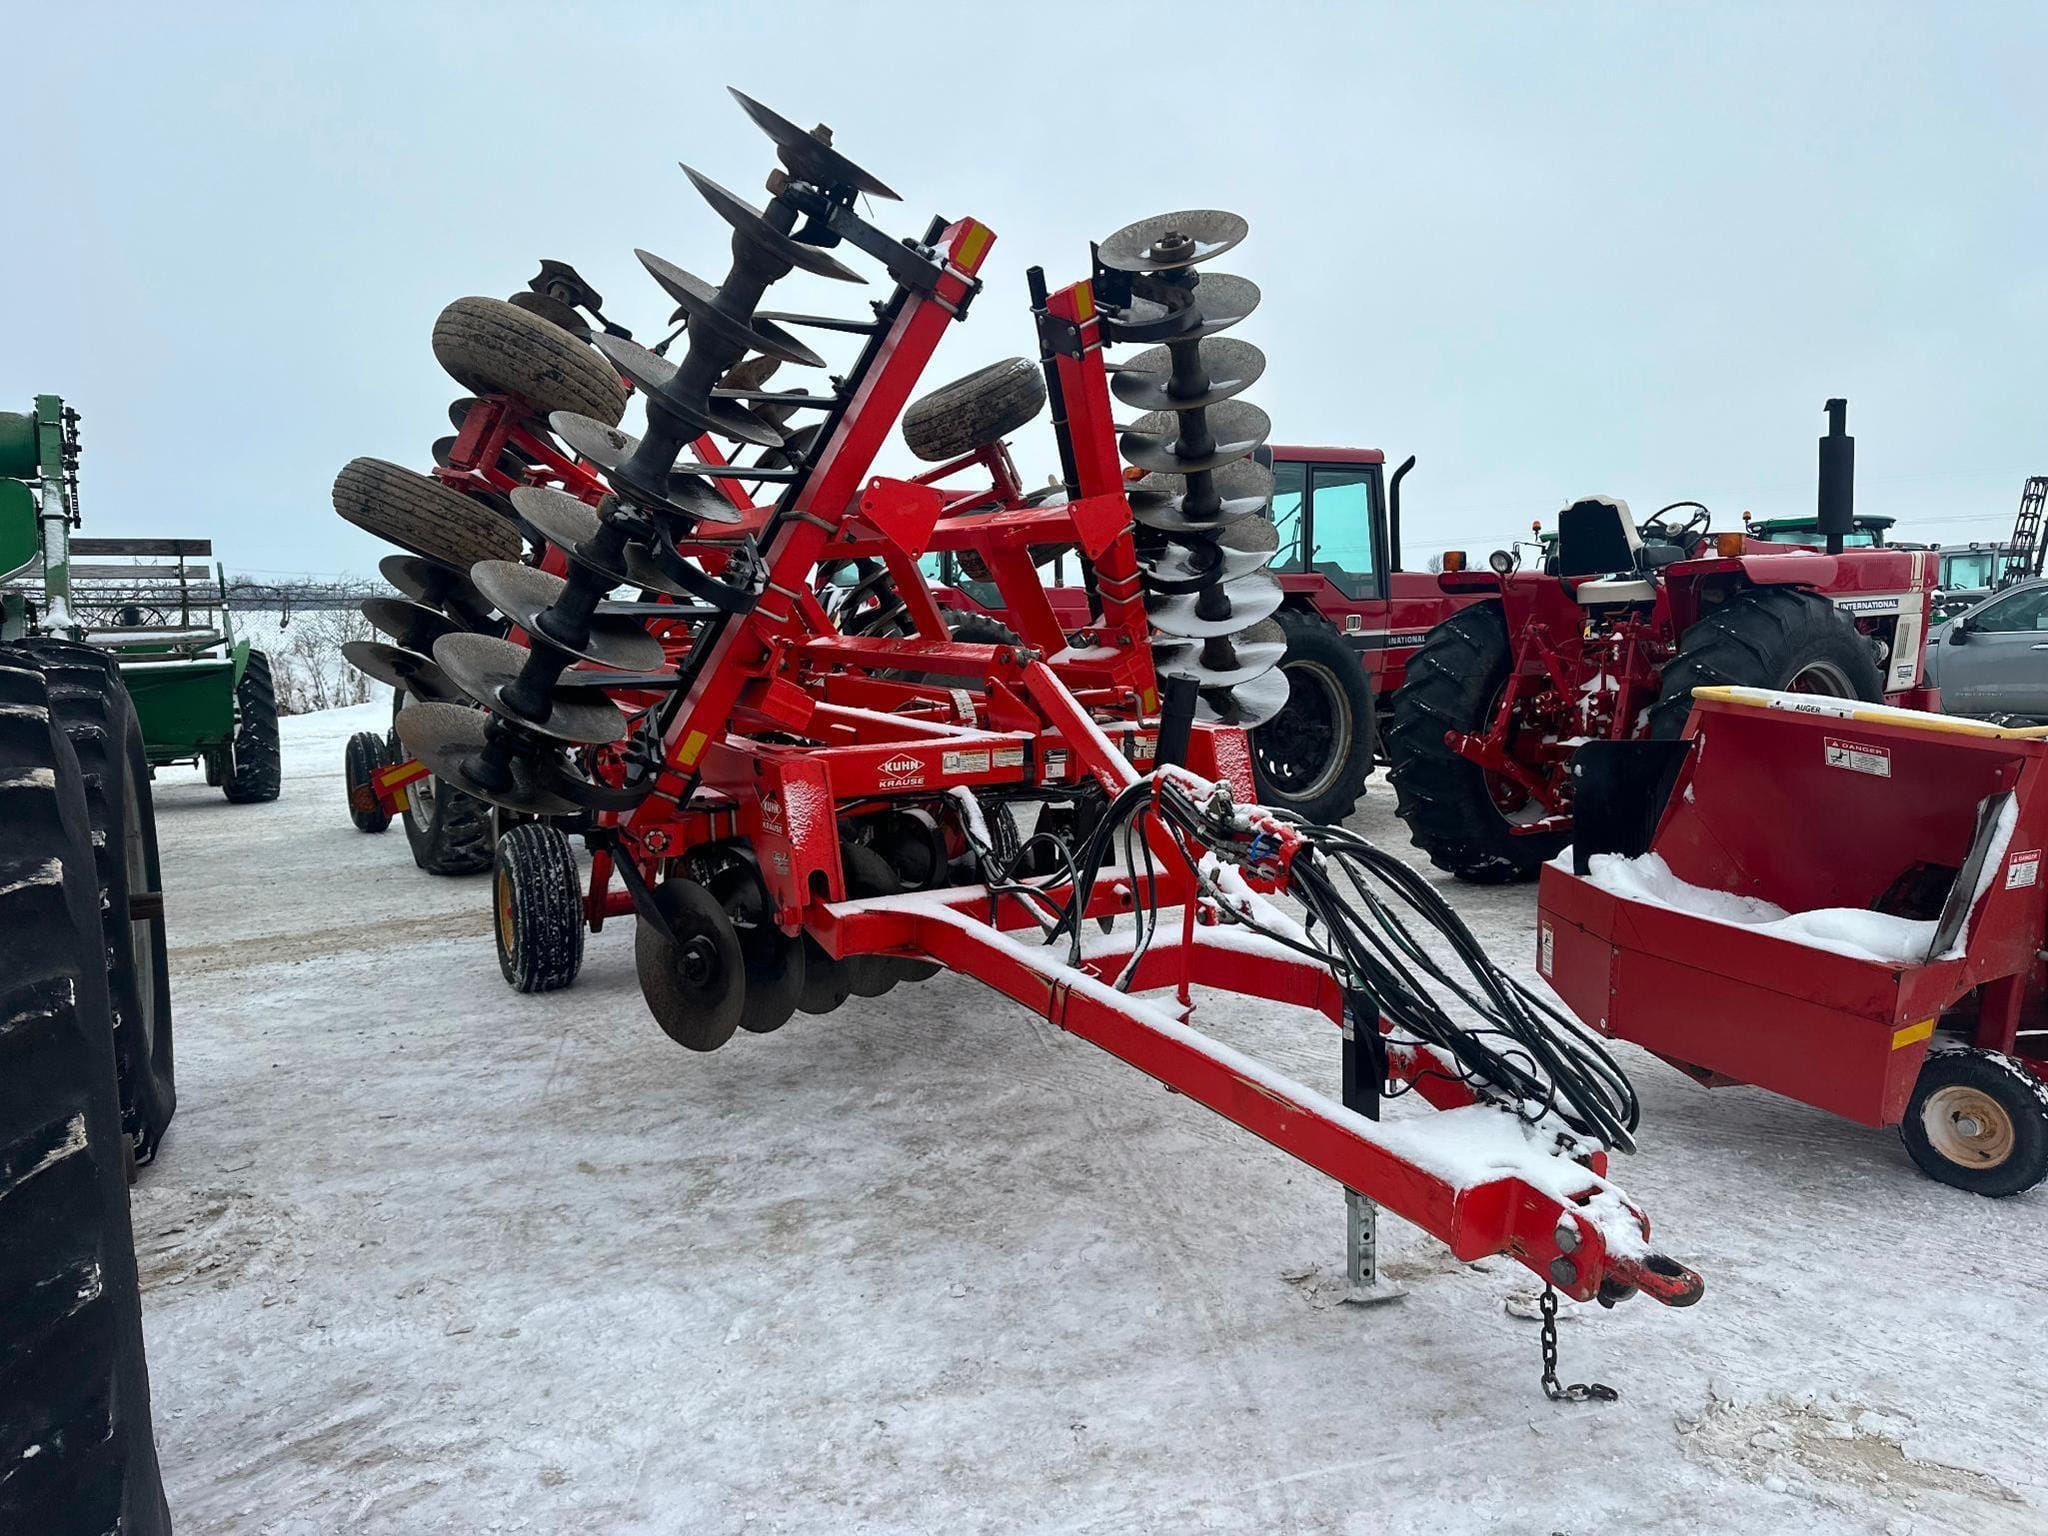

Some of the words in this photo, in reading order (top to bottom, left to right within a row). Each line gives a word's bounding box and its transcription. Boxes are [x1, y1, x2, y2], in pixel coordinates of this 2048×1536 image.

[1840, 601, 1897, 610] INTERNATIONAL
[1795, 704, 1821, 713] AUGER
[1841, 742, 1882, 755] DANGER
[884, 760, 919, 772] KUHN
[879, 778, 925, 788] KRAUSE
[762, 800, 780, 814] KUHN
[762, 821, 783, 834] KRAUSE
